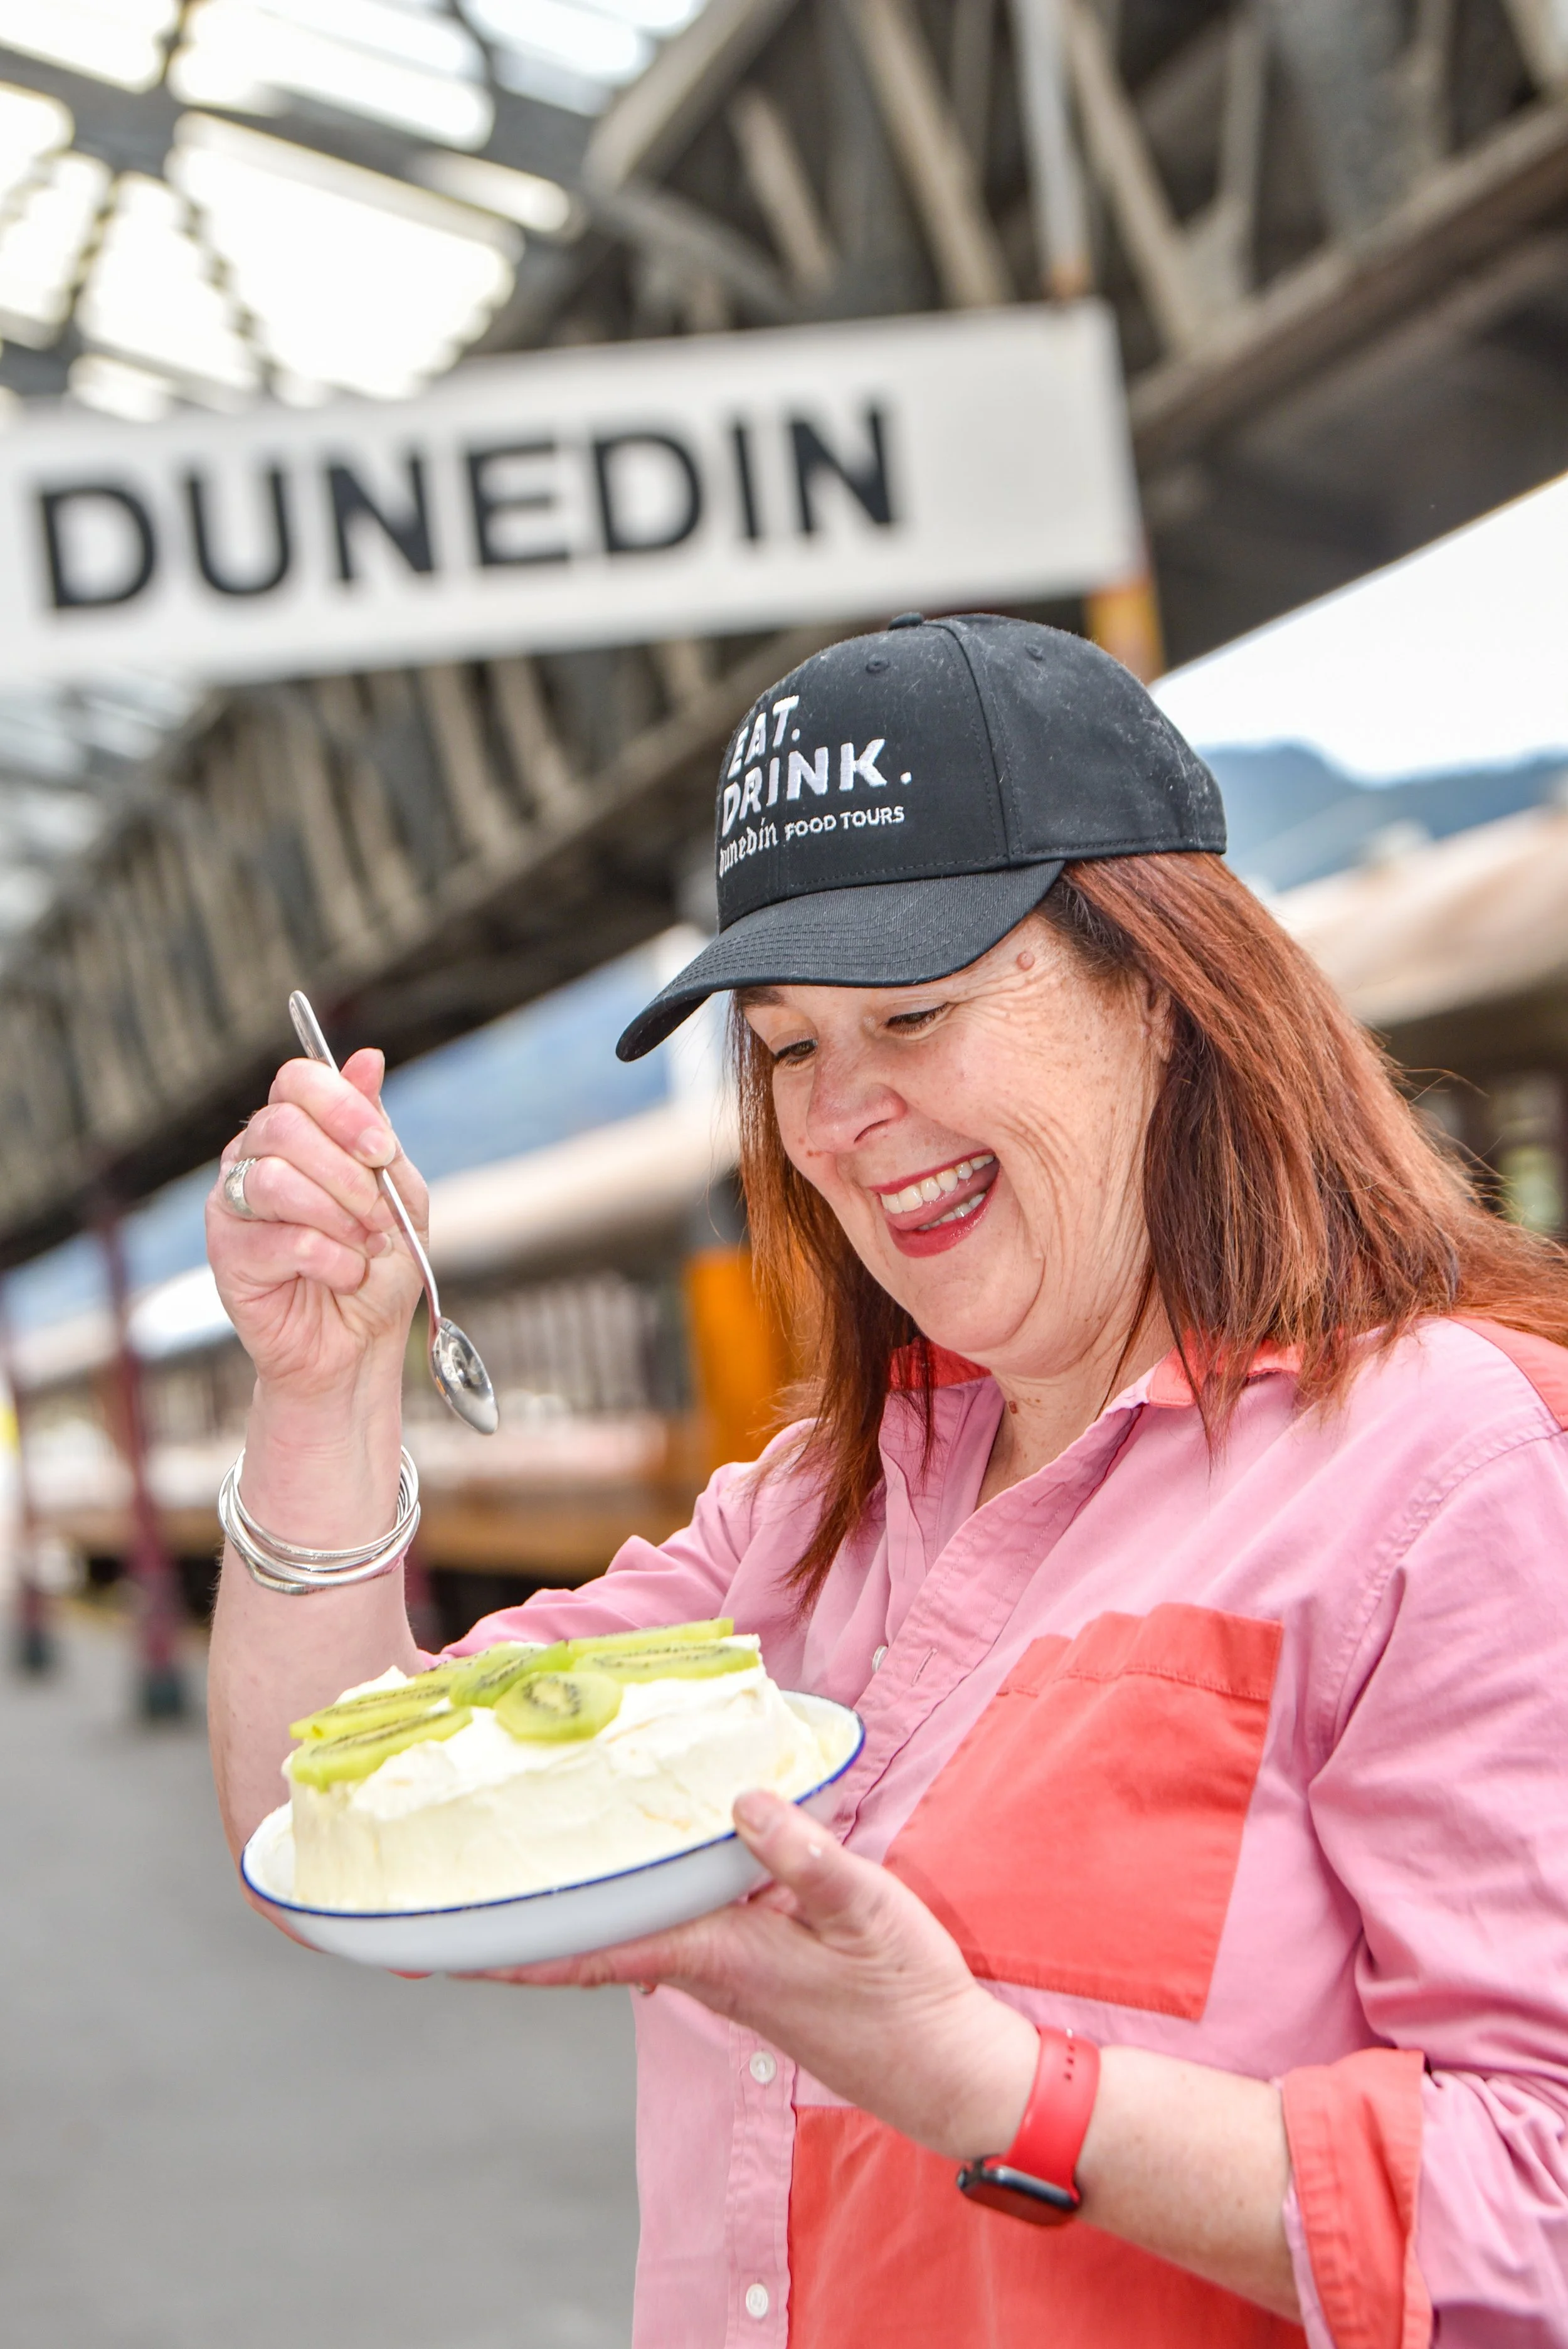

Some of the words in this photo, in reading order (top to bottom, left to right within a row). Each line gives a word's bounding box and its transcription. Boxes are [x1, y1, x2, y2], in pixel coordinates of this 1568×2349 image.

[36, 400, 898, 612] DUNEDIN
[728, 695, 800, 779] EAT.
[722, 738, 912, 837] DRINK.
[785, 814, 837, 841] FOOD
[840, 805, 905, 830] TOURS
